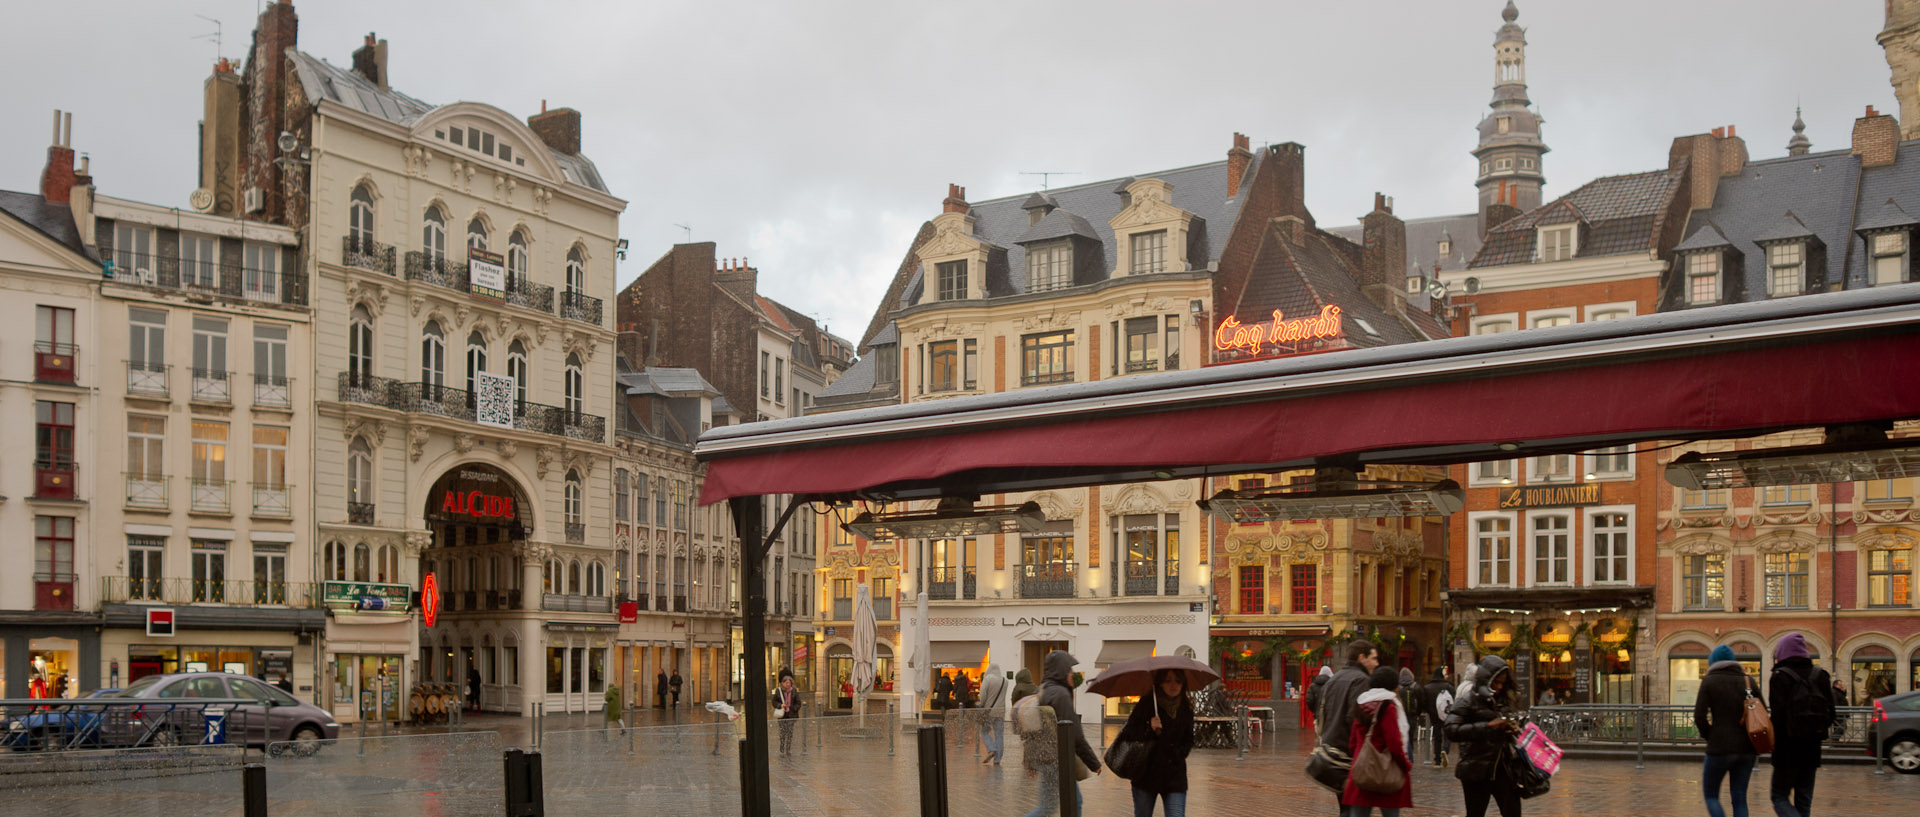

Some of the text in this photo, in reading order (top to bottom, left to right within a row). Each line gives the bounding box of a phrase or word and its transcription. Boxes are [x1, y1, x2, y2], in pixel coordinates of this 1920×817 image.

[475, 263, 500, 275] Flashez
[1215, 304, 1341, 355] Coq hardi
[460, 469, 499, 483] RESTAURANT
[1500, 485, 1599, 508] La HOUBLONNIERE
[442, 490, 514, 519] ALCIDE
[328, 585, 342, 593] BAR
[1002, 616, 1090, 627] LANCEL
